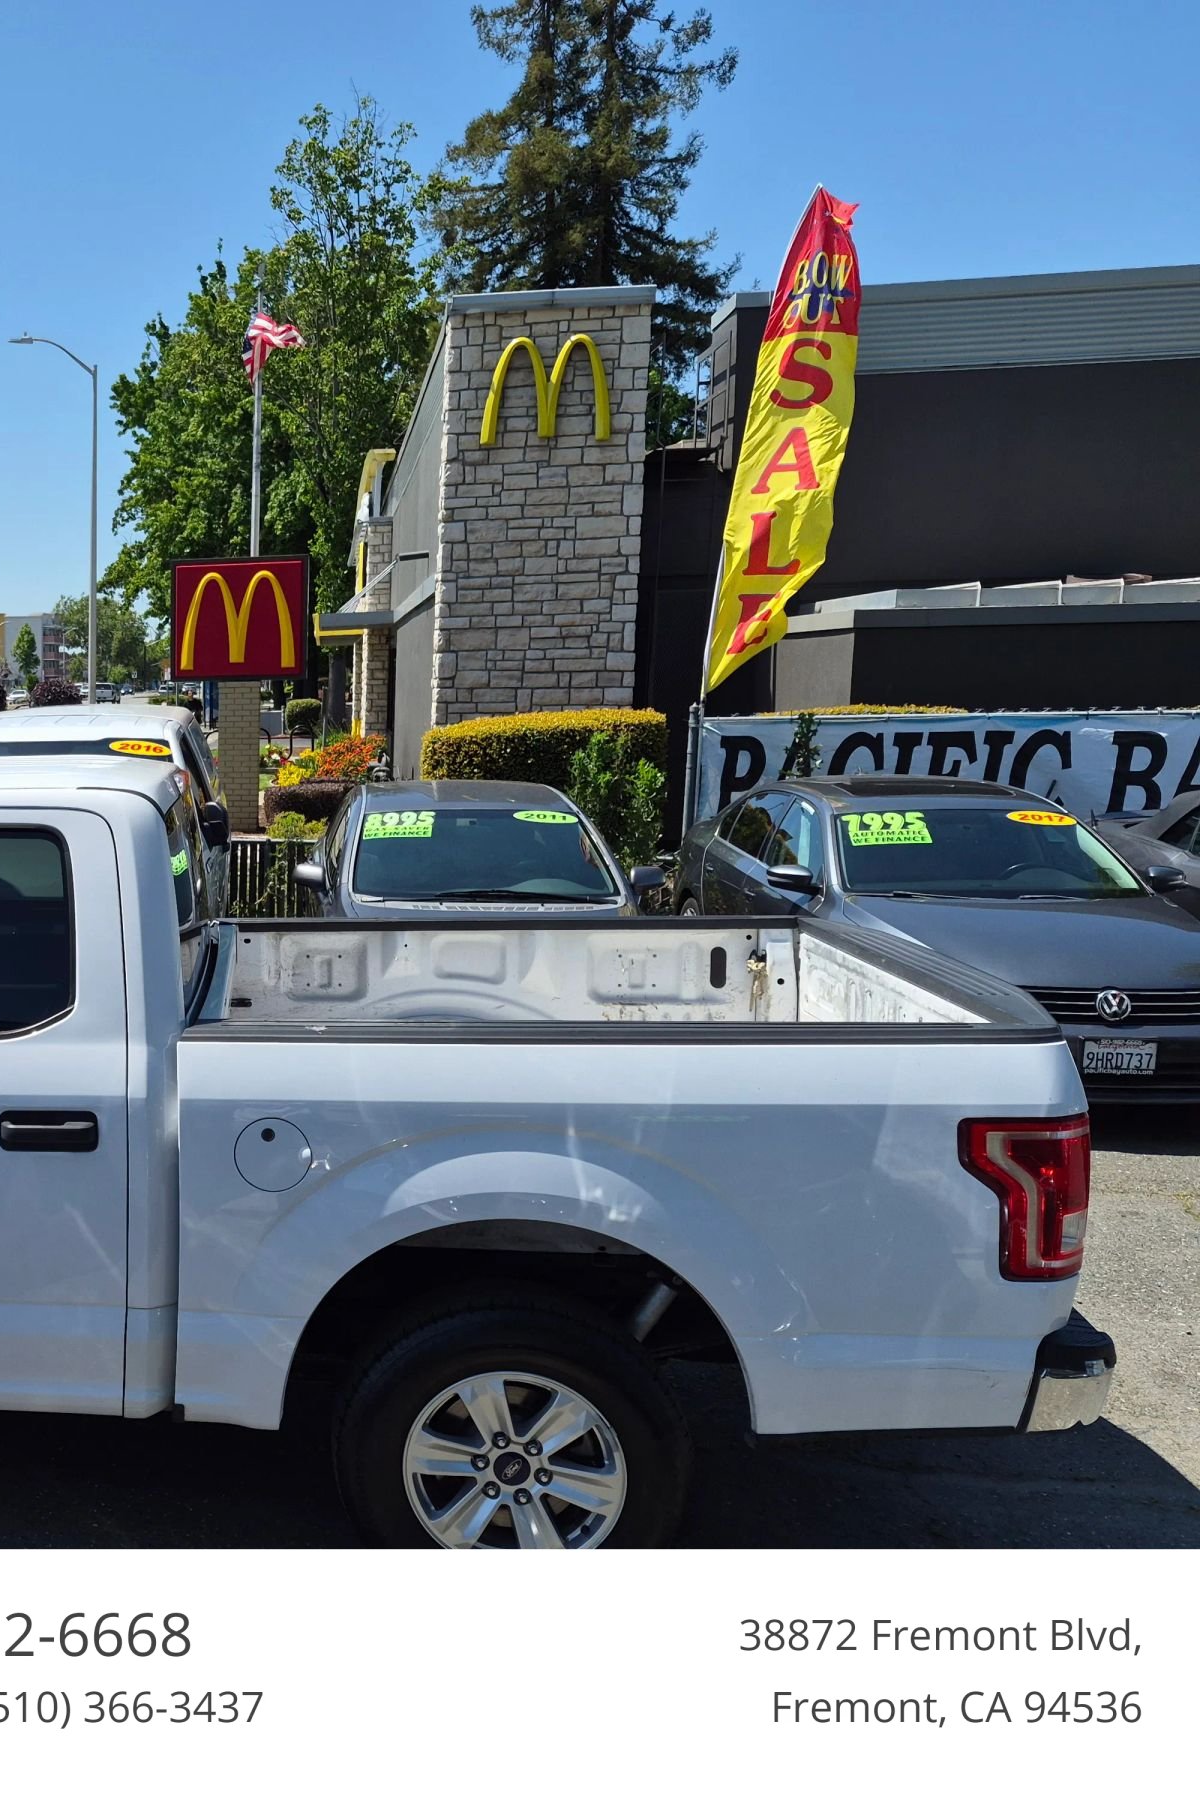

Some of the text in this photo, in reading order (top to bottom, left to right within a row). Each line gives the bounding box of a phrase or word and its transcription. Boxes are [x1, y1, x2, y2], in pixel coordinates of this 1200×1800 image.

[783, 293, 845, 329] OUT
[118, 743, 164, 753] 2016
[365, 811, 436, 828] 8995
[524, 813, 567, 821] 2011
[841, 812, 927, 832] 7995
[1018, 814, 1065, 822] 2017
[852, 830, 926, 838] AUTOMATIC
[1086, 1051, 1153, 1069] 9HRD737
